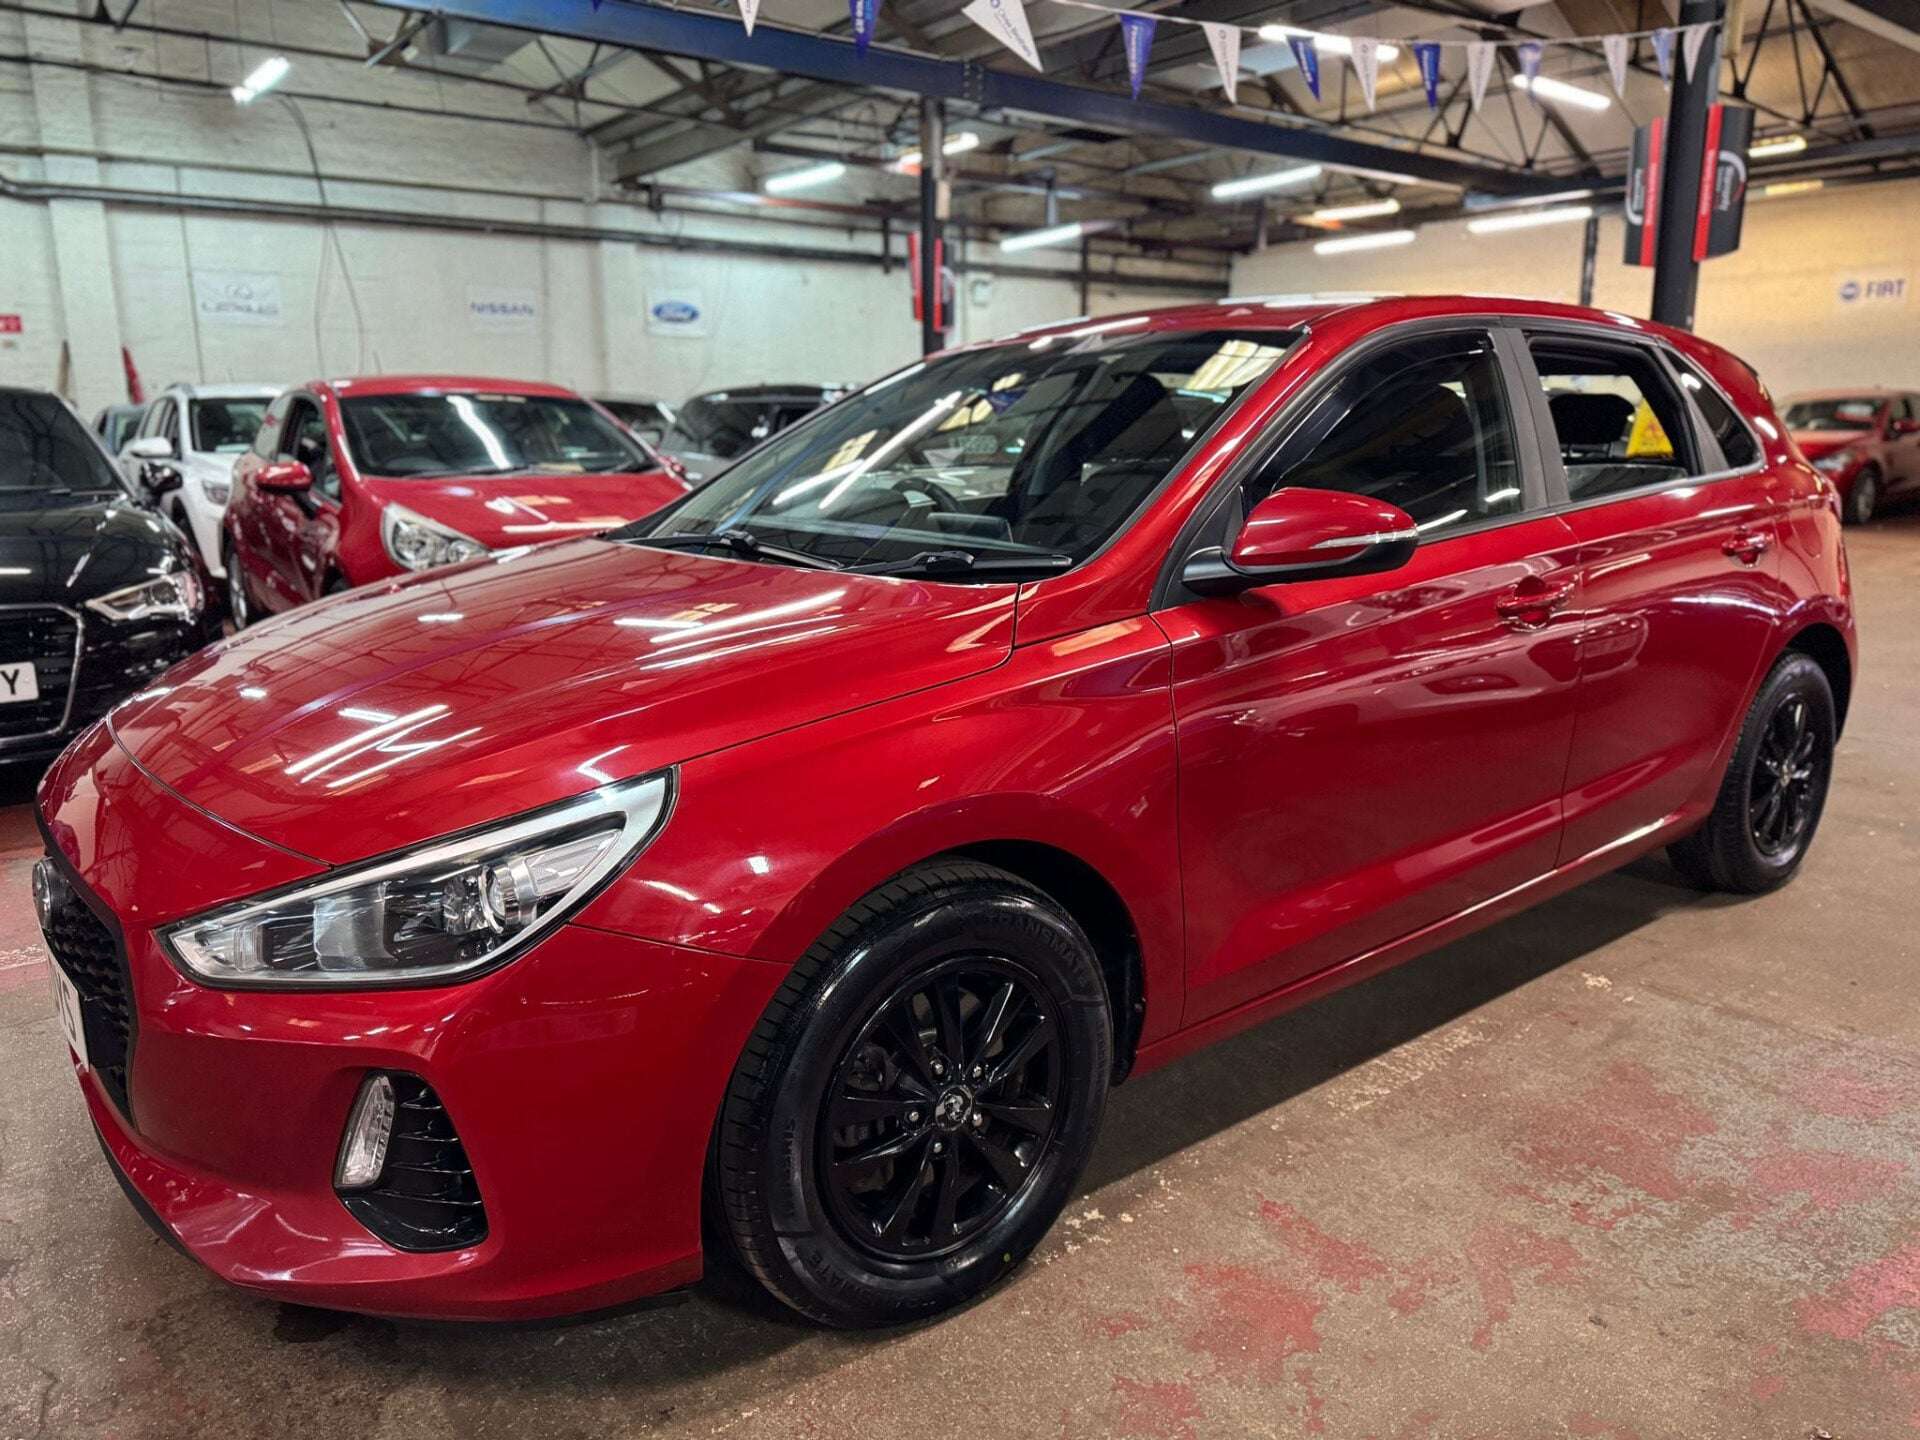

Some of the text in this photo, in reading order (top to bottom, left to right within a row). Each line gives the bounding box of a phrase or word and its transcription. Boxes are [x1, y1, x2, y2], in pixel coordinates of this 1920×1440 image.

[1865, 279, 1906, 298] FIAT
[469, 302, 535, 316] NISSAN
[0, 668, 20, 696] Y
